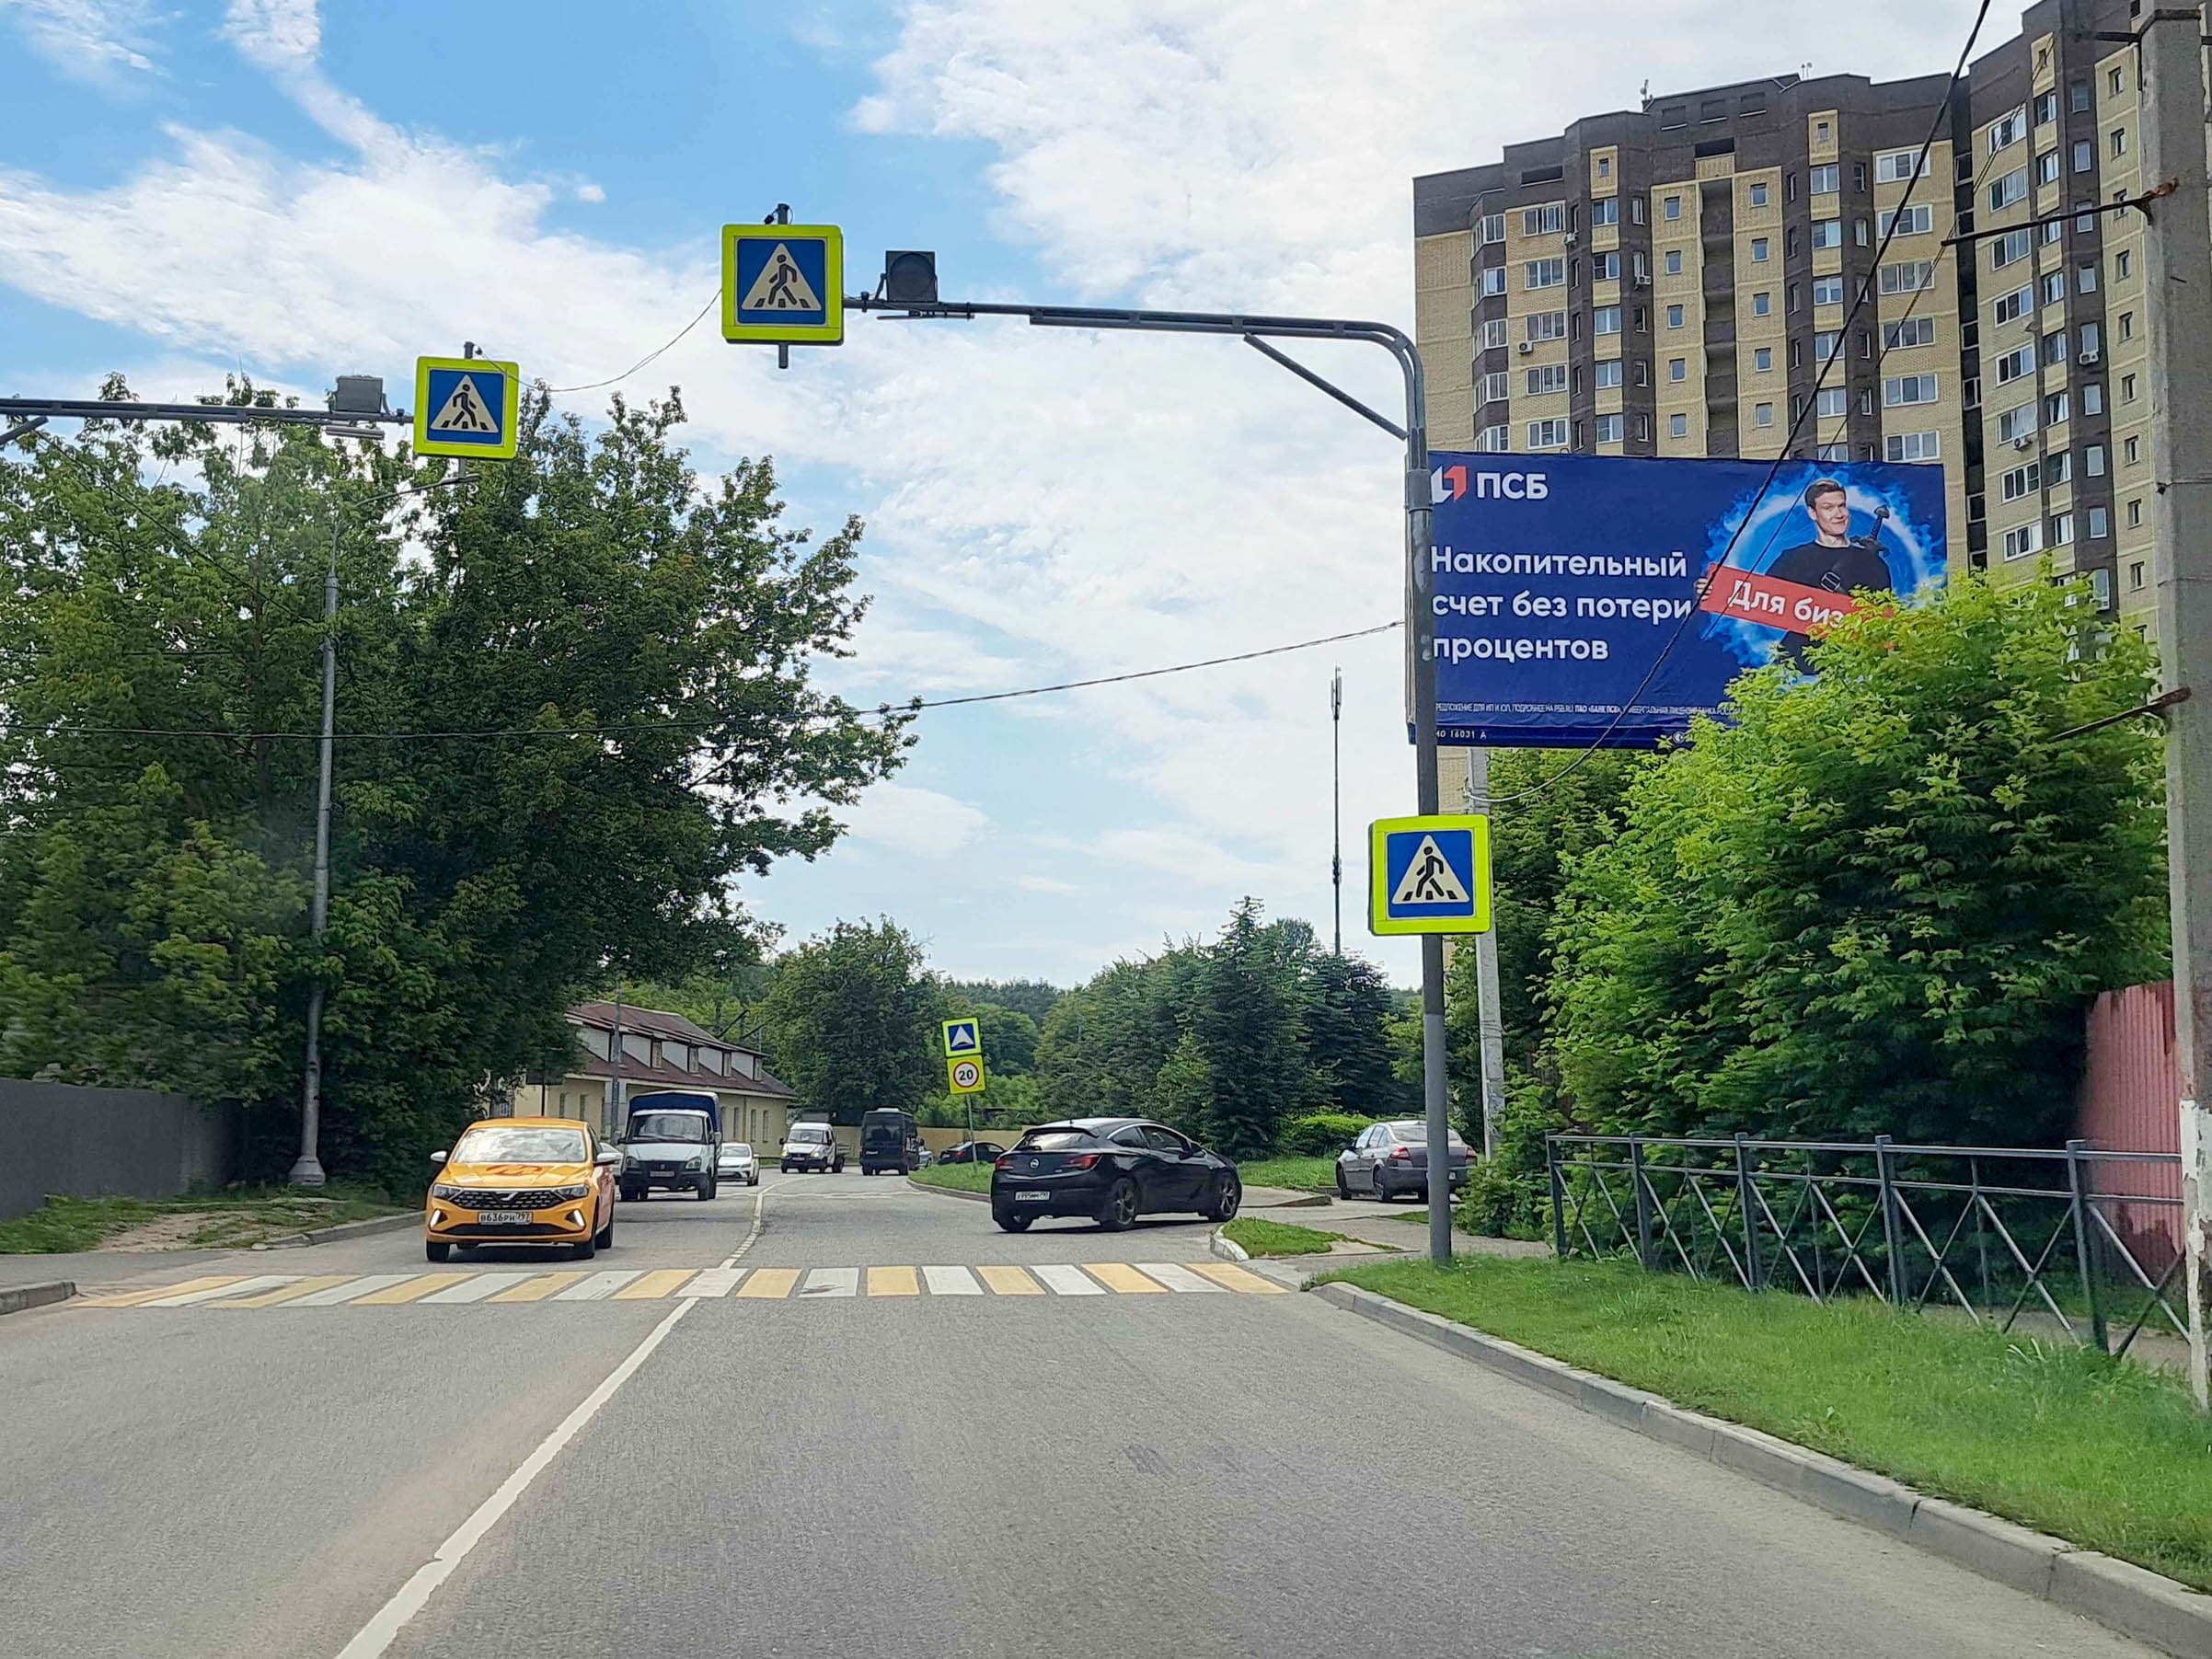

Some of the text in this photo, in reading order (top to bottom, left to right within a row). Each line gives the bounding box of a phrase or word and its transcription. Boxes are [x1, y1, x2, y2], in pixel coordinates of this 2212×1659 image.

[1476, 472, 1549, 500] ПСБ
[1431, 545, 1688, 577] Накопительный
[1432, 589, 1692, 625] счет без потери
[1728, 579, 1845, 628] Для биз
[1433, 637, 1609, 664] процентов
[958, 1068, 974, 1081] 20
